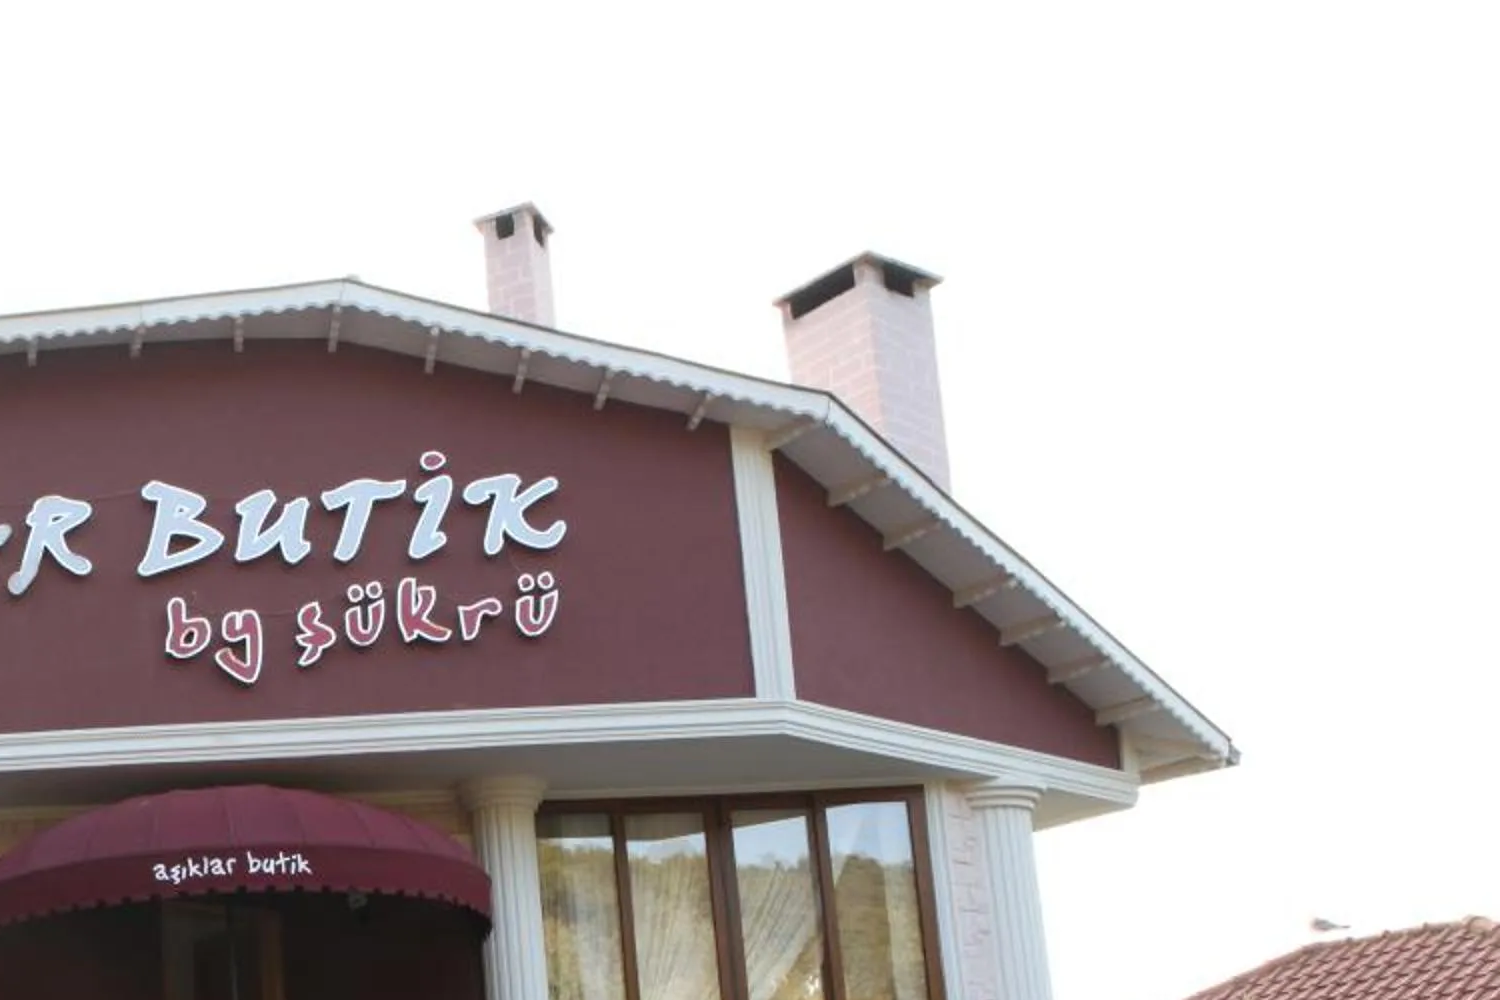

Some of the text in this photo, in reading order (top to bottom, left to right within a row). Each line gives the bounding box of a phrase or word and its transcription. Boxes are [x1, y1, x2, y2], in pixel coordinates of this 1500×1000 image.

[165, 597, 262, 683] by
[152, 851, 312, 884] aşıklar butik
